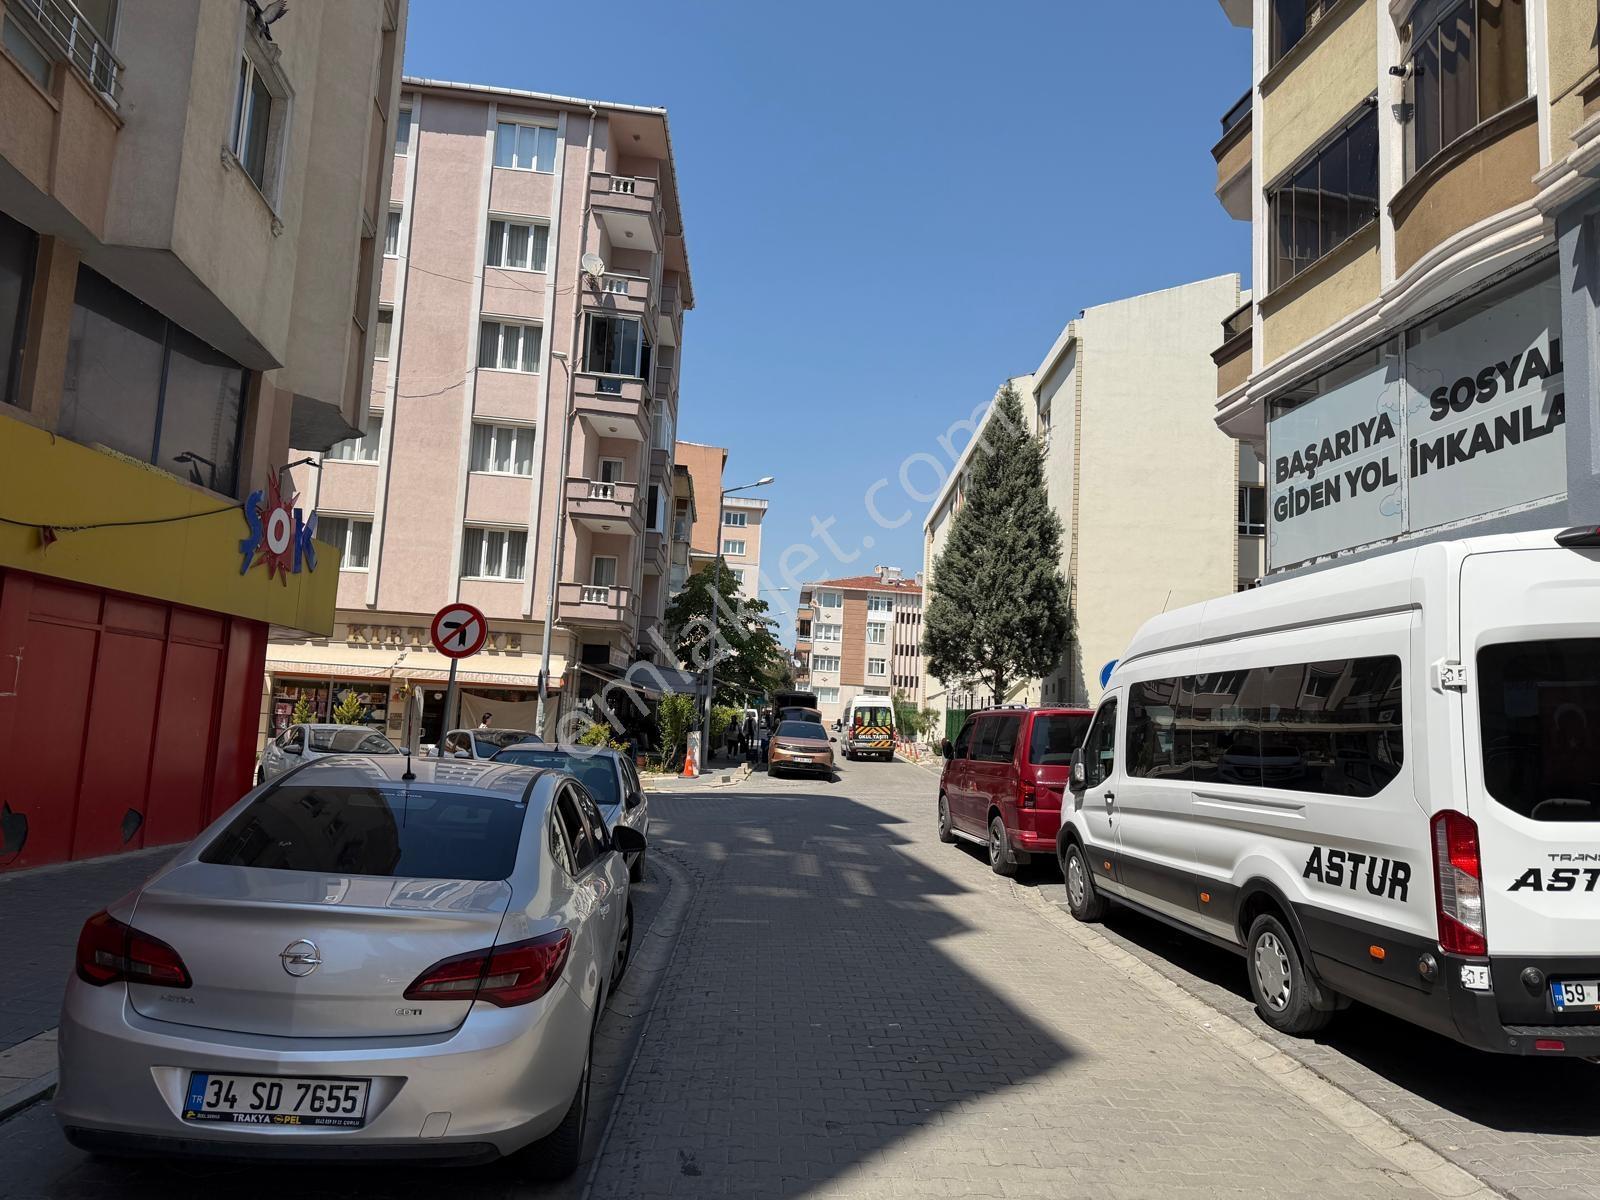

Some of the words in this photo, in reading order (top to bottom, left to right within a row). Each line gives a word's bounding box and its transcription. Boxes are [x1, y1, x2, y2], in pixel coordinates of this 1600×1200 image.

[1430, 338, 1564, 421] SOSYAL
[1276, 412, 1396, 484] BAŞARIYA
[1274, 474, 1341, 522] GİDEN
[1345, 456, 1398, 498] YOL
[239, 489, 318, 577] ŞOK
[345, 624, 521, 651] KIRTYE
[1302, 846, 1411, 903] ASTUR
[1547, 853, 1600, 862] TRAN
[1564, 984, 1585, 1003] 59
[192, 1095, 203, 1104] TR
[206, 1079, 238, 1109] 34
[249, 1082, 283, 1111] SD
[293, 1083, 360, 1113] 7655
[232, 1113, 271, 1123] TRAKYA
